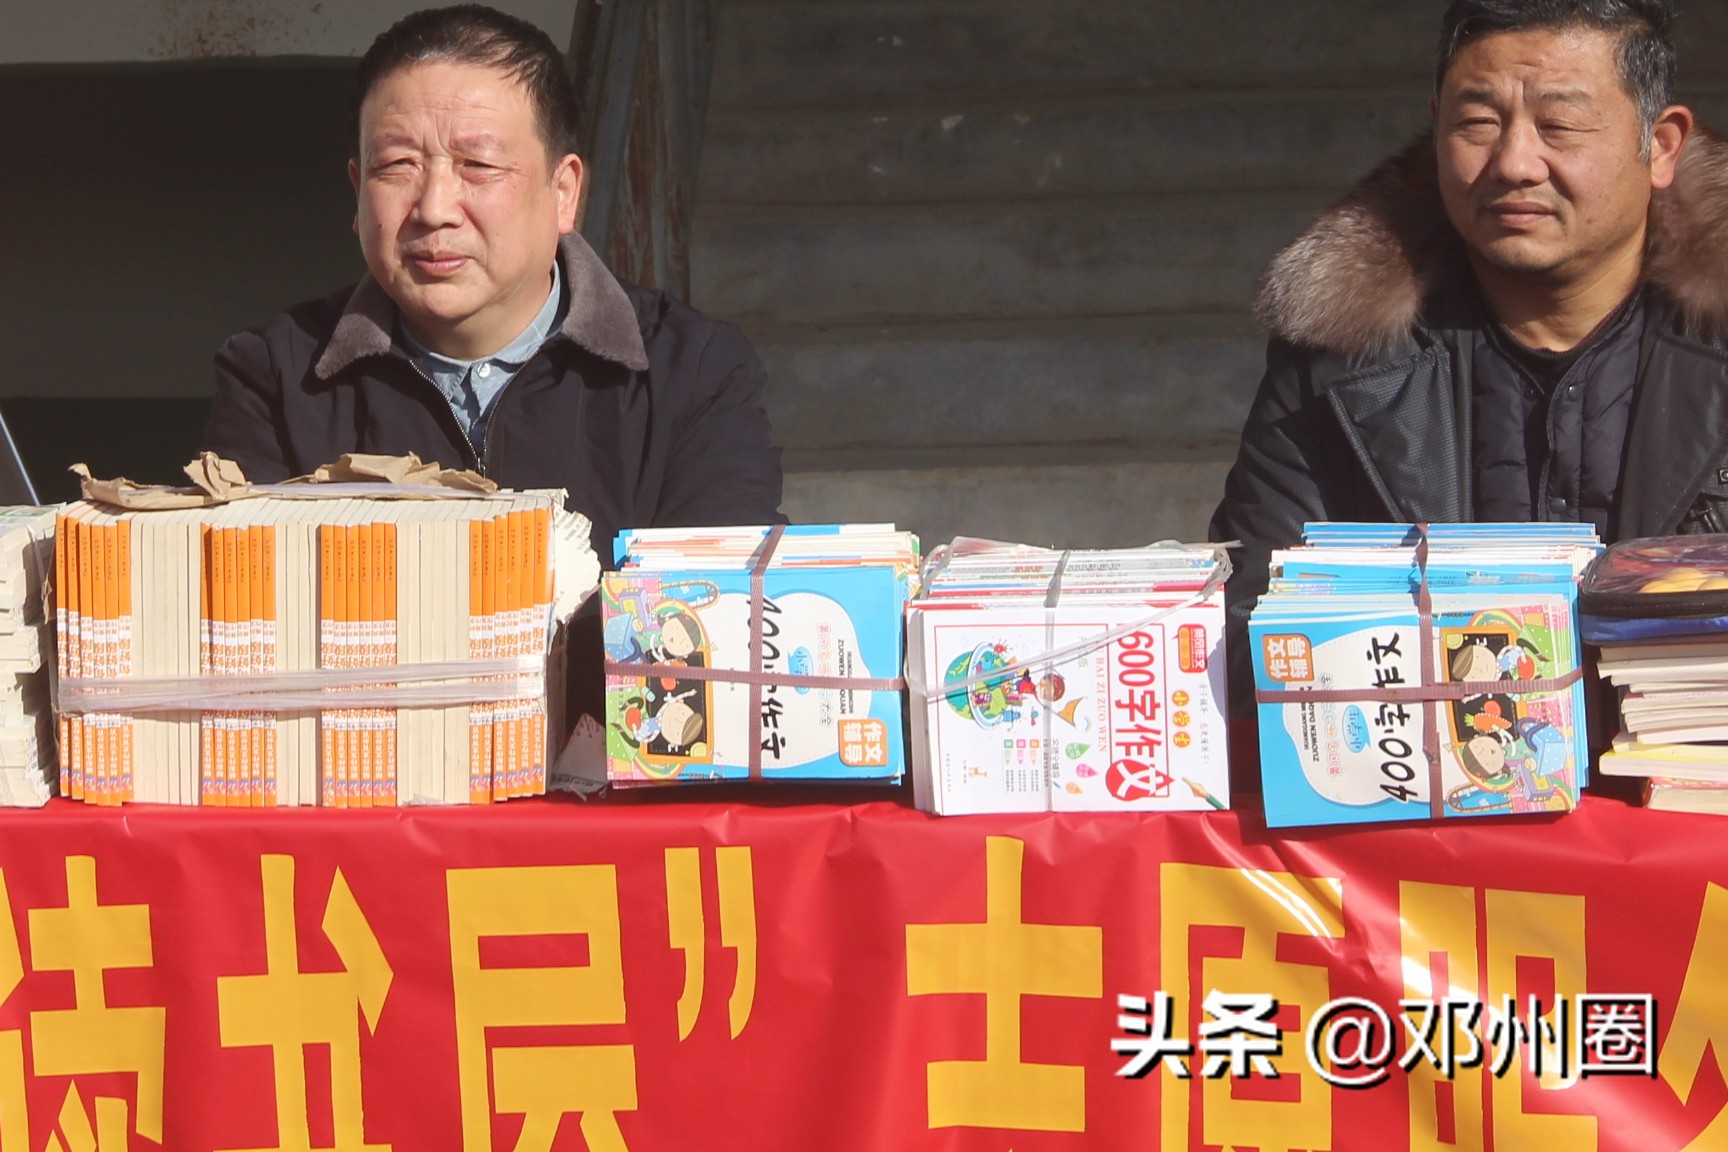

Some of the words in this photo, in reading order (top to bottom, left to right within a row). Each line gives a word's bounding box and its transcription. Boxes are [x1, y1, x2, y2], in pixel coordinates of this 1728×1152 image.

[838, 639, 847, 676] ZUOWEN
[1268, 638, 1288, 679] 作文
[1287, 637, 1308, 679] 辅导
[1115, 630, 1165, 801] 600字作文
[1347, 709, 1363, 750] 小学生
[843, 722, 863, 763] 辅导
[864, 722, 883, 763] 作文
[1309, 725, 1320, 763] ZUOWEN
